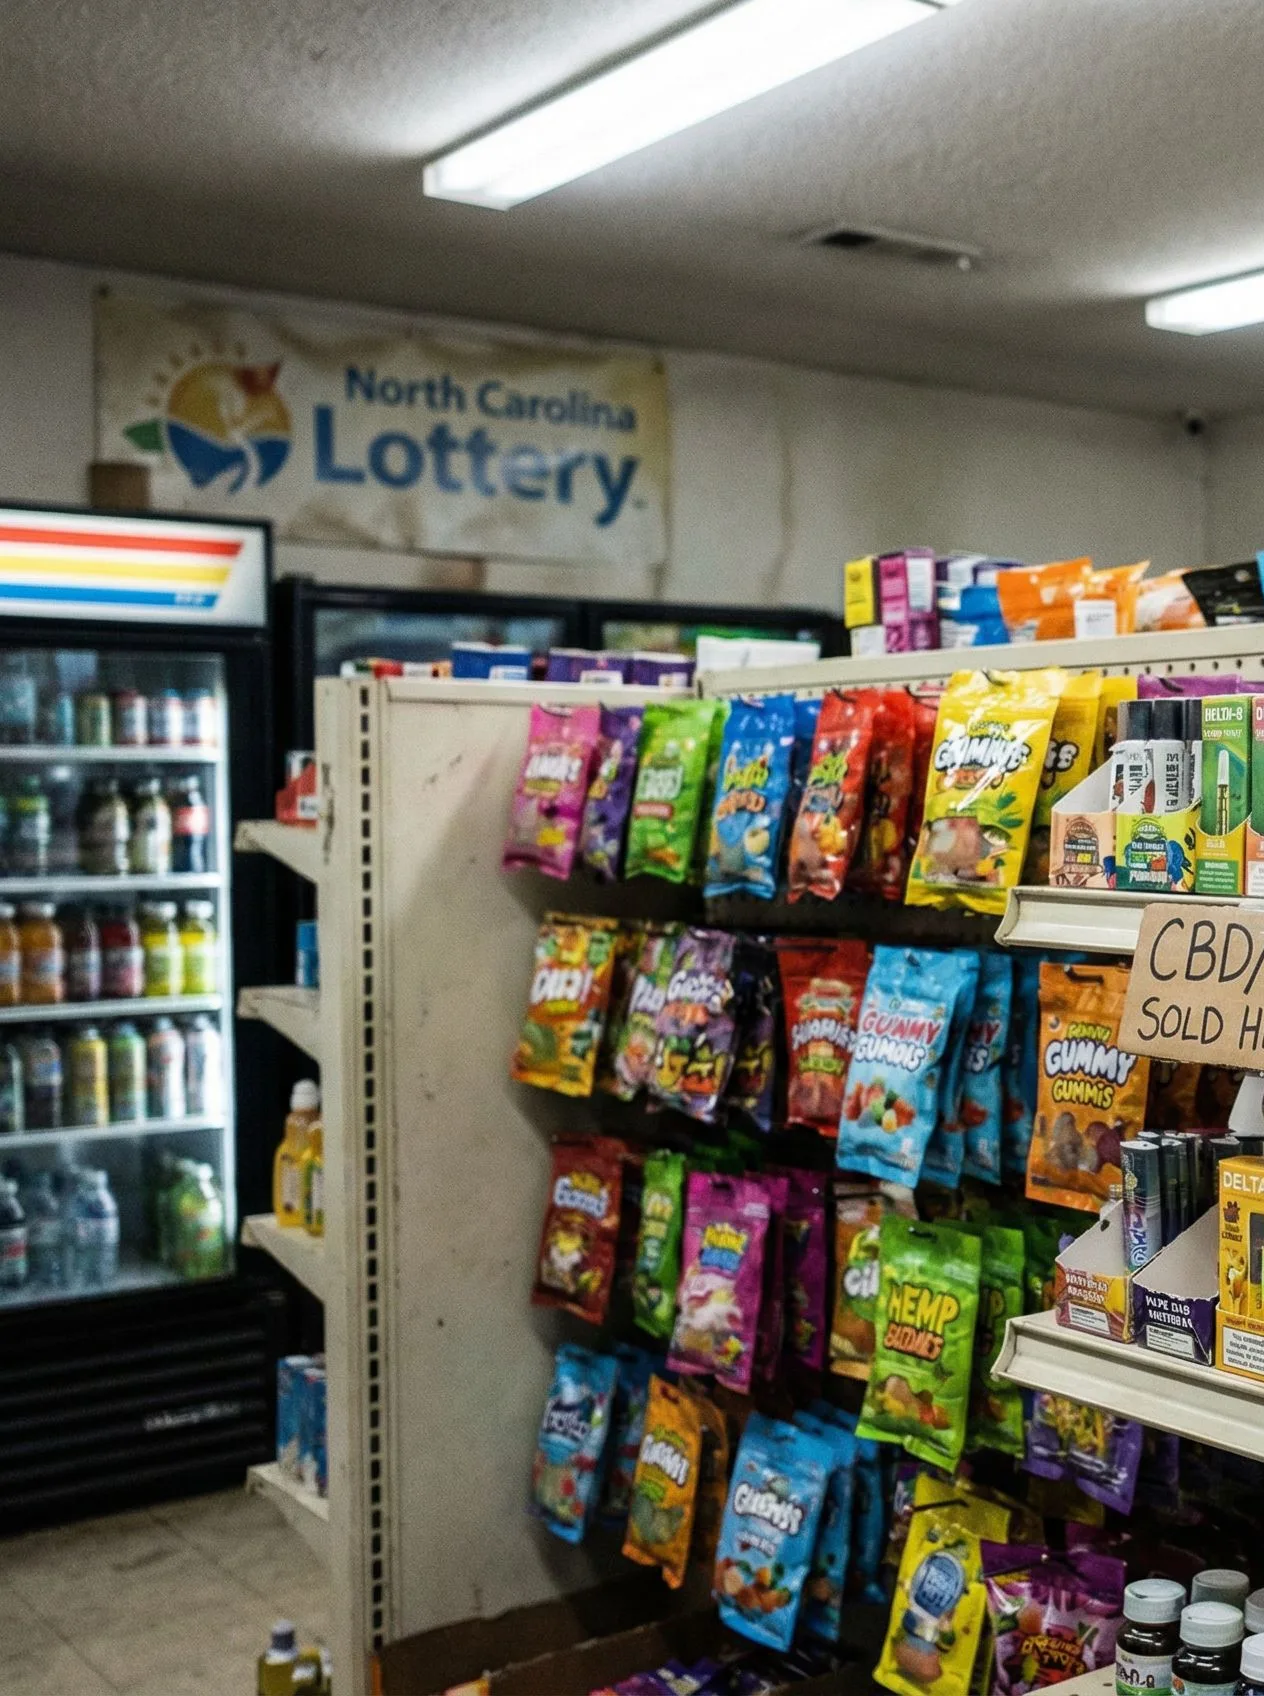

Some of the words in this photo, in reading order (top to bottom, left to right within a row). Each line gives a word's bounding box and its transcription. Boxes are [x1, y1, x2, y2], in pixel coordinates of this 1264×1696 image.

[346, 366, 466, 413] North
[476, 380, 638, 434] Carolina
[313, 404, 639, 528] Lottery
[1137, 996, 1224, 1045] SOLD
[1045, 1037, 1139, 1084] GUMMY
